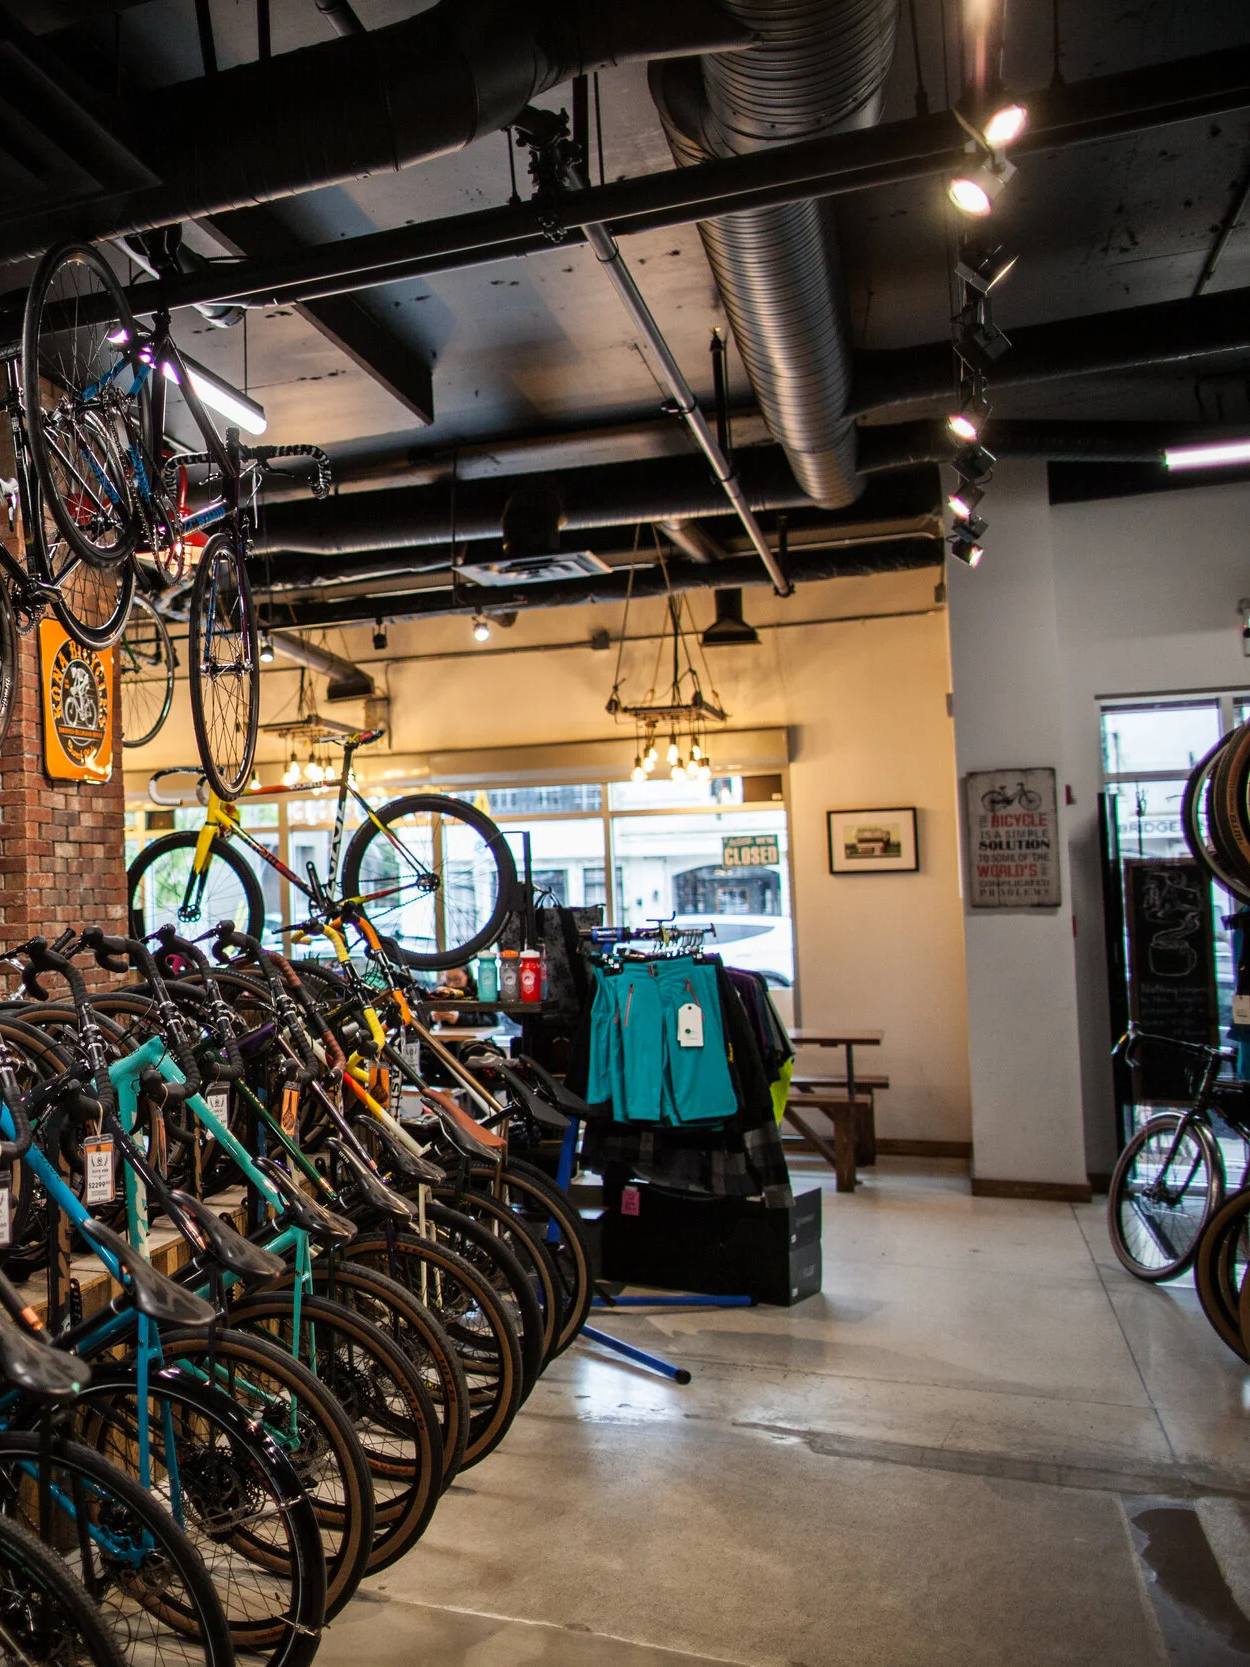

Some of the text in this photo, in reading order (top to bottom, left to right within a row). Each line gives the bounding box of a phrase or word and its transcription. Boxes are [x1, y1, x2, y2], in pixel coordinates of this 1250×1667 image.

[51, 651, 69, 720] KONA
[991, 812, 1047, 828] BICYCLE
[1005, 828, 1049, 839] SIMPLE
[979, 839, 1050, 850] SOLUTION
[724, 845, 778, 866] CLOSED
[977, 863, 1038, 878] WORLD'S
